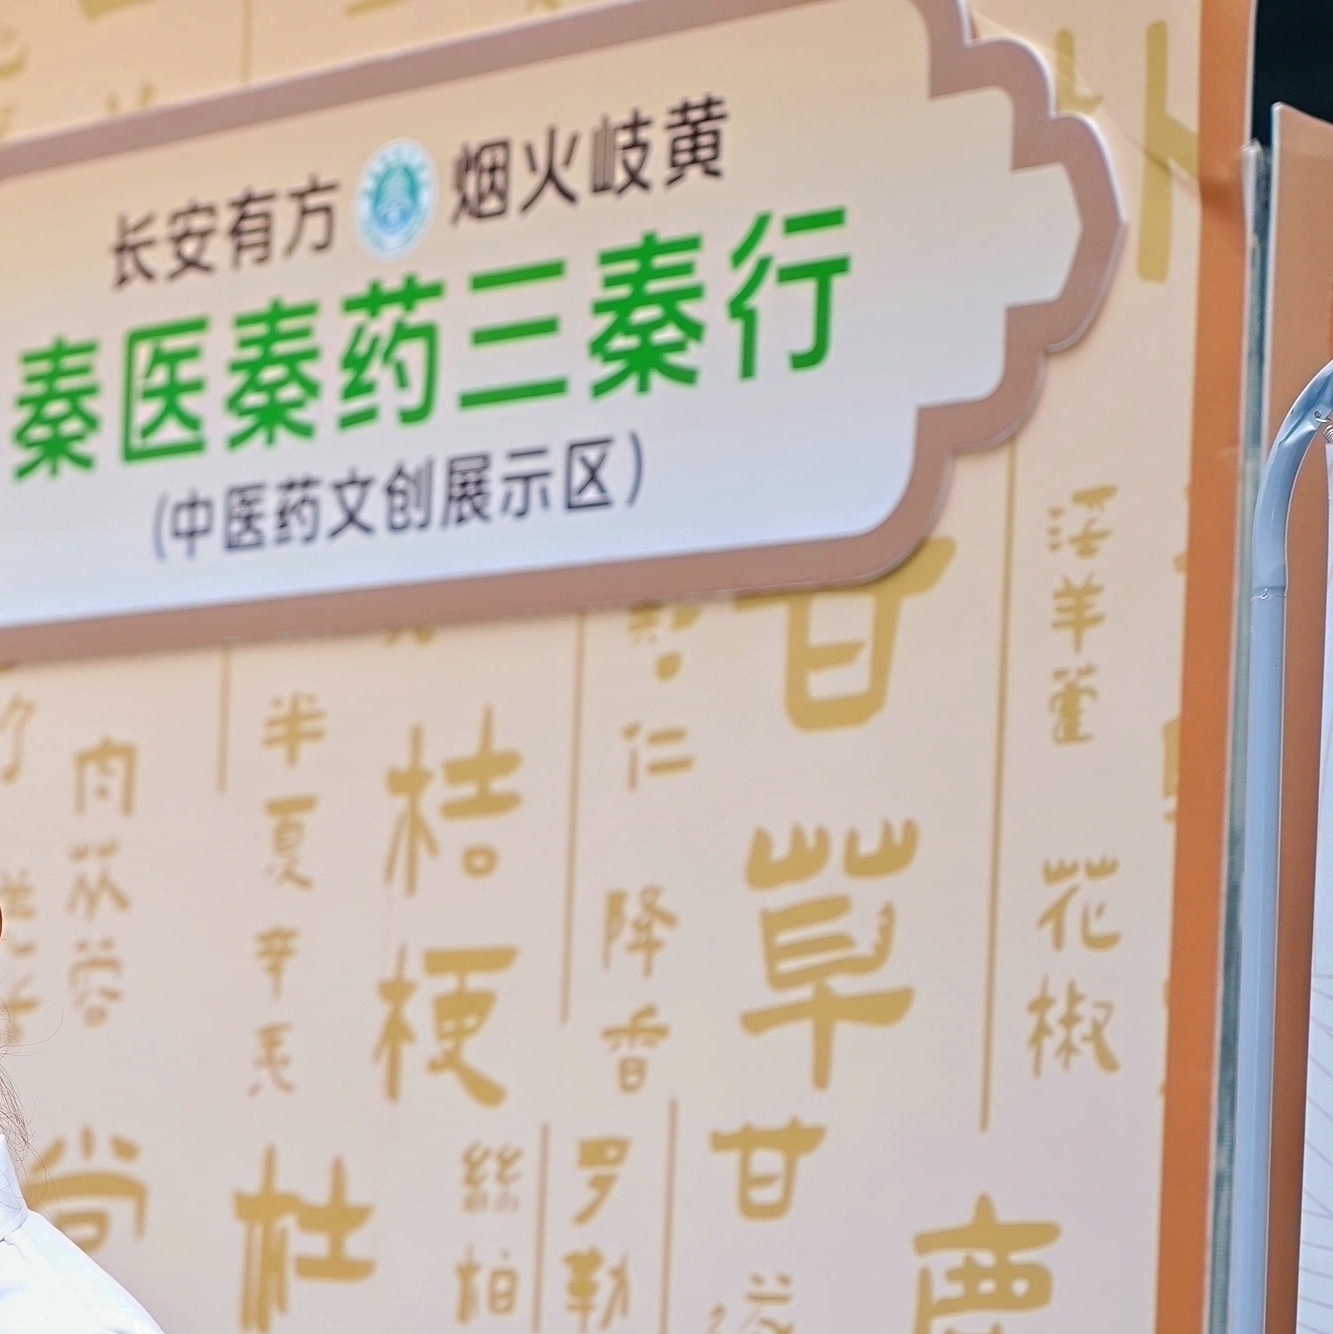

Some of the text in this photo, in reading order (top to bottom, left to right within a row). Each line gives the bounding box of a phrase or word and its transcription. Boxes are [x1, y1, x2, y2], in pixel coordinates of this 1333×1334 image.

[111, 174, 341, 291] 长安有方
[450, 94, 730, 226] 烟火岐黄
[11, 206, 852, 482] 秦医秦药三秦行
[153, 431, 645, 562] (中医药文创展示区)
[374, 705, 525, 1107] 桔梗
[602, 884, 678, 1094] 降香
[1027, 855, 1122, 1079] 花椒
